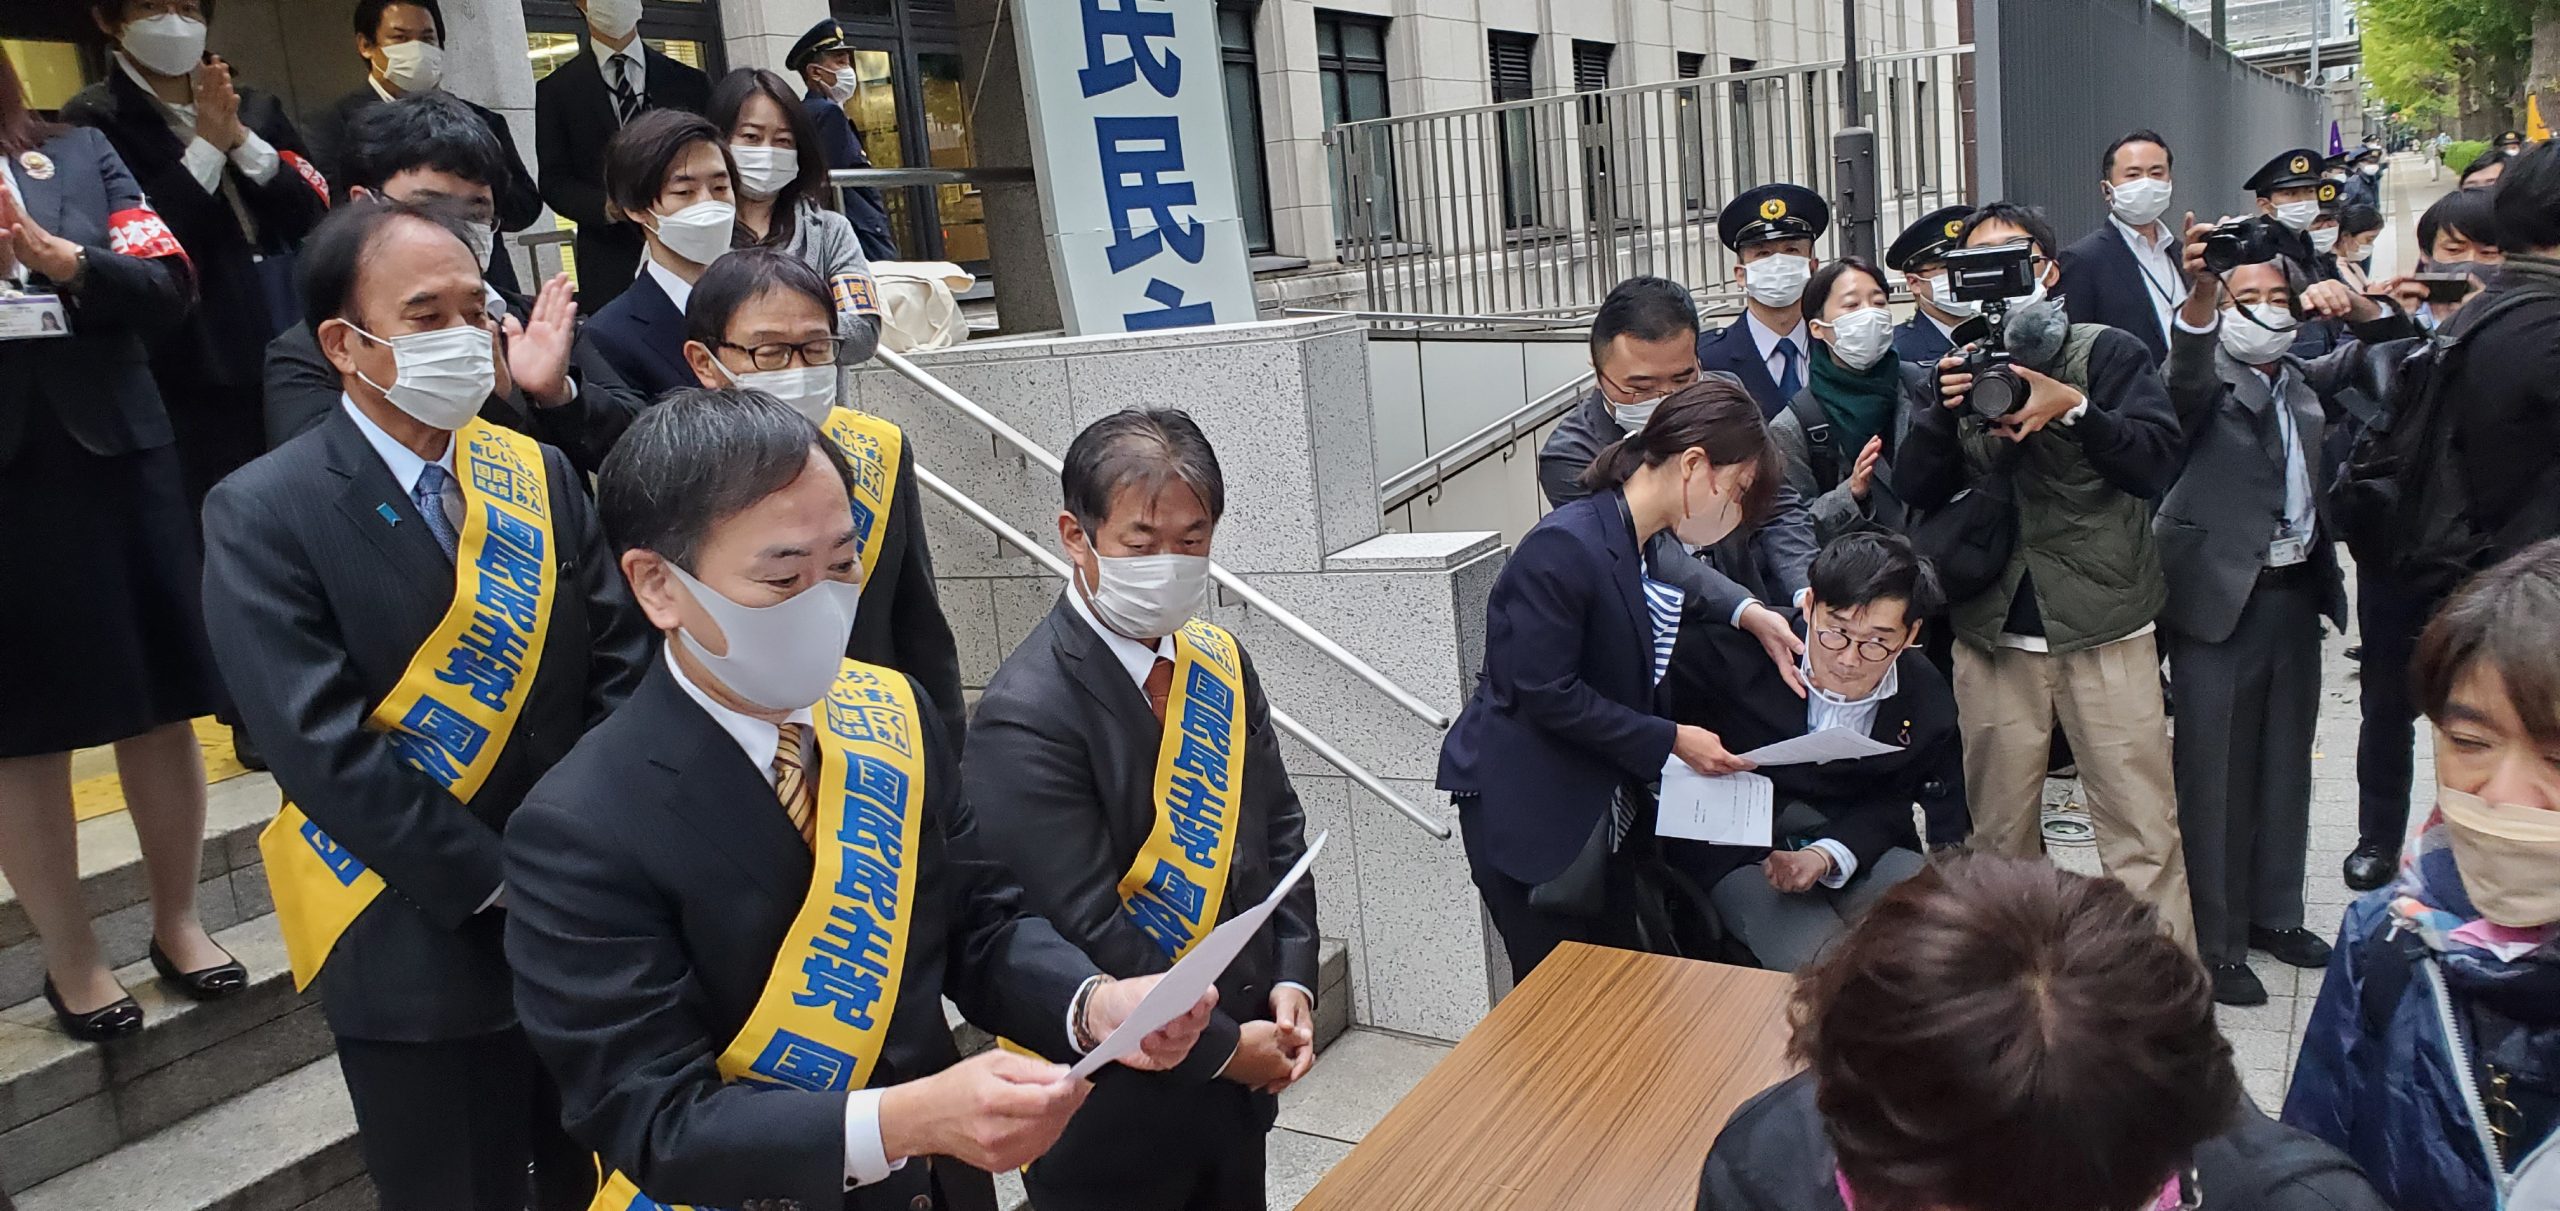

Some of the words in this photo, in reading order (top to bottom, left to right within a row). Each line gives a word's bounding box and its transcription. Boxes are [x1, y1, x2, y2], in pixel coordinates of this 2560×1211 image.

[434, 500, 545, 713] 国民民主党
[1166, 659, 1235, 869] 国民民主党
[791, 748, 910, 1031] 国民民主党
